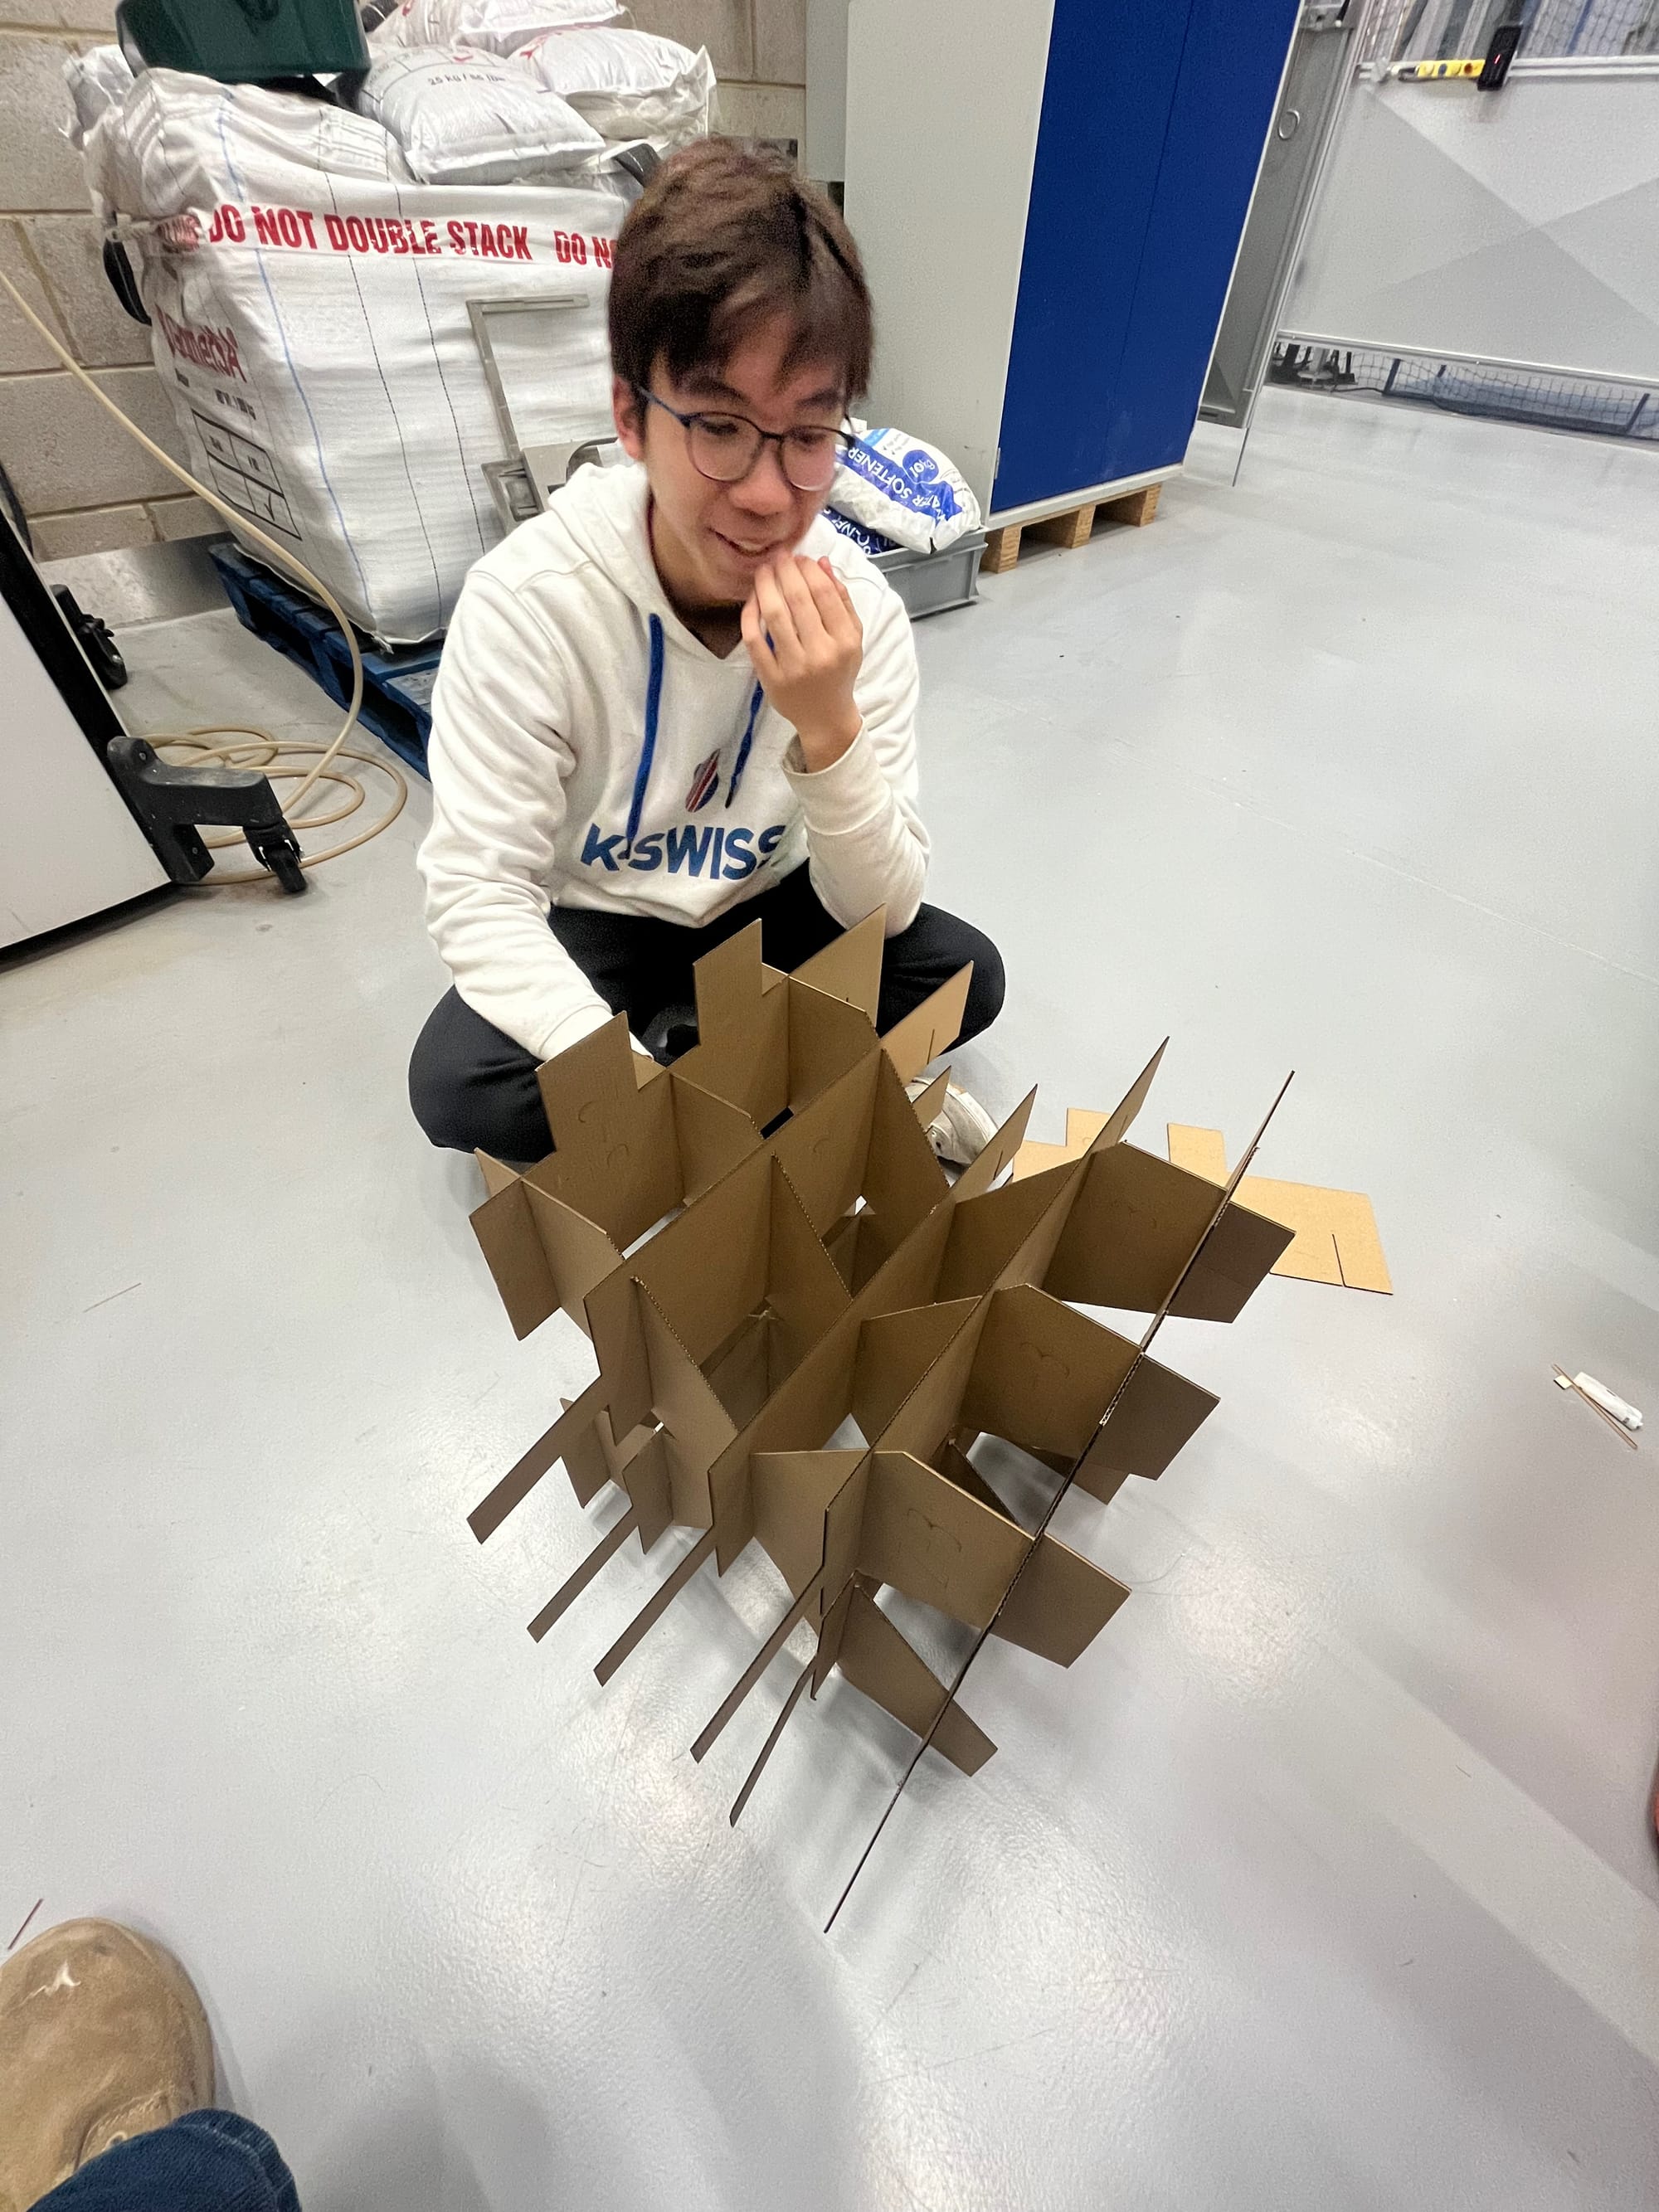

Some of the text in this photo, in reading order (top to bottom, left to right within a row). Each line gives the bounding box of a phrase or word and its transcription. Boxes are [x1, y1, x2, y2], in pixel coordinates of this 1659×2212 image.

[251, 205, 319, 250] NOT
[324, 213, 442, 255] DOUBLE
[446, 220, 533, 260] STACK
[553, 230, 587, 265] DO
[847, 445, 912, 499] SOFTENER
